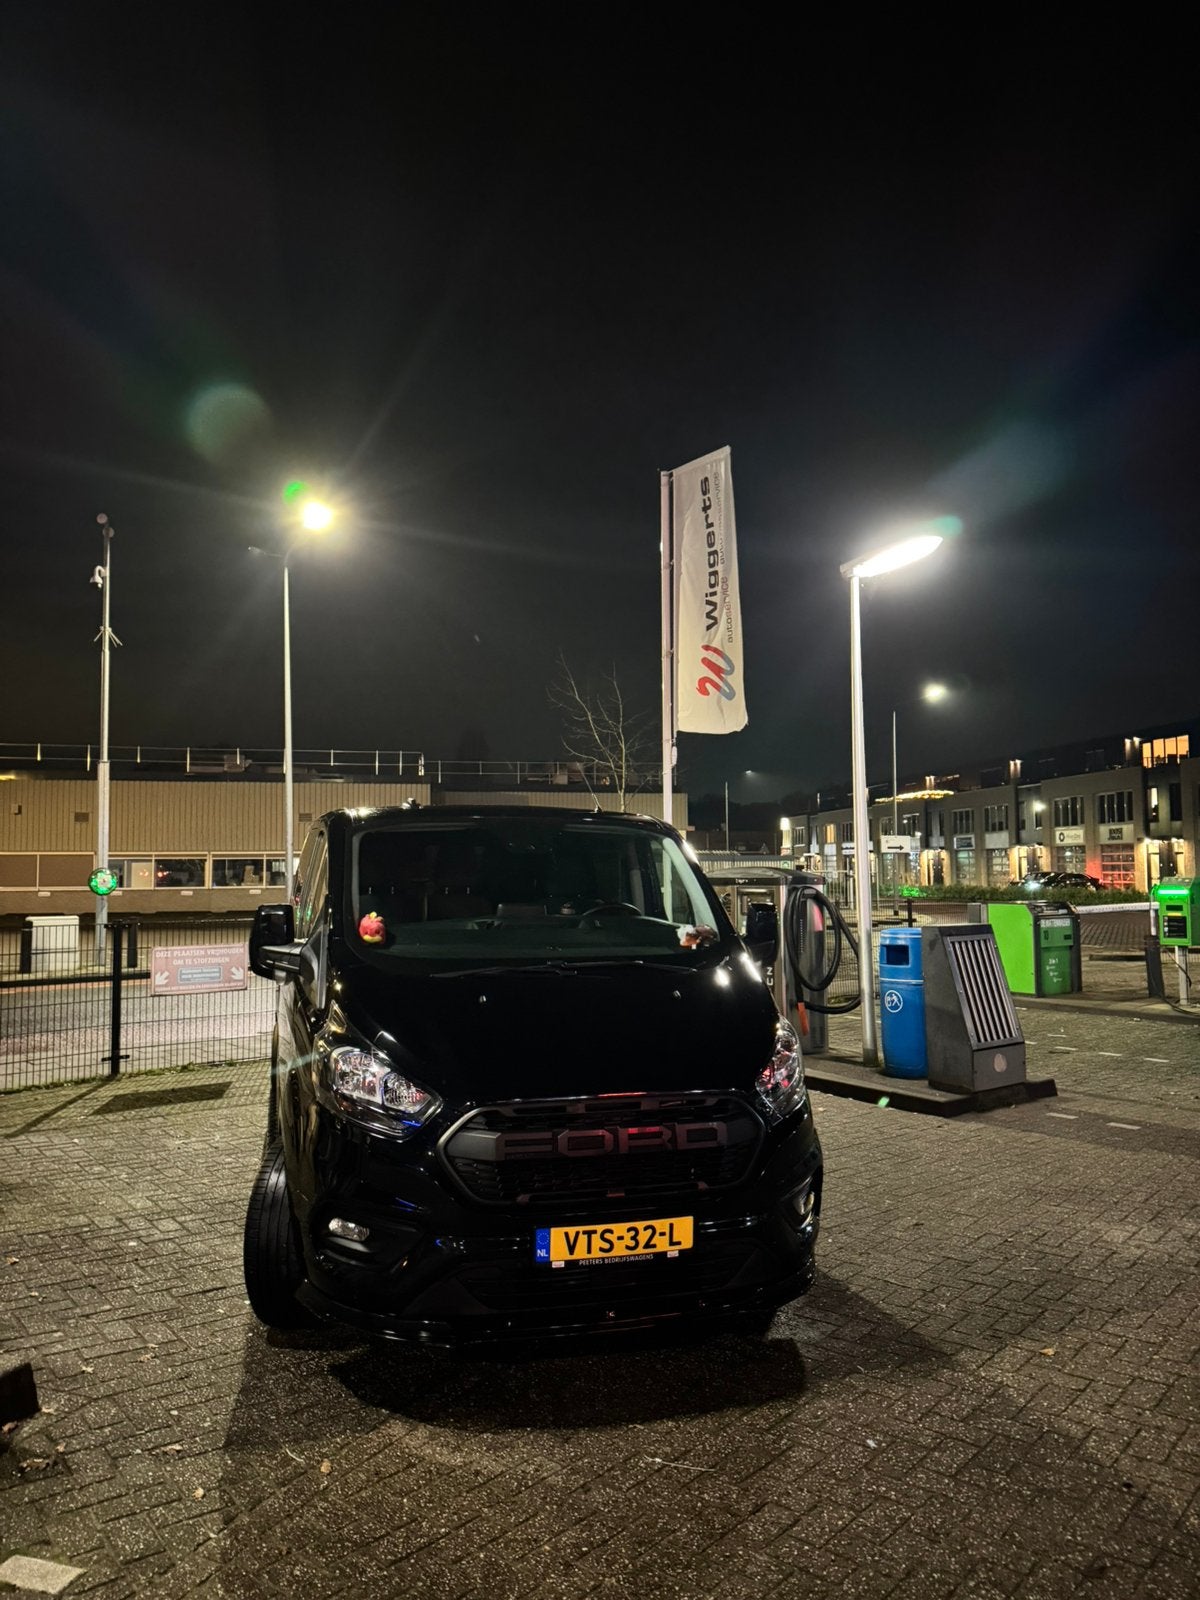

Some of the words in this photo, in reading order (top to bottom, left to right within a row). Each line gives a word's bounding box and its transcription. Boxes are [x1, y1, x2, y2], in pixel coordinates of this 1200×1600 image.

[700, 475, 720, 632] Wiggerts
[720, 575, 733, 643] autoservice
[173, 948, 205, 957] PLAATSEN
[495, 1121, 728, 1161] FORD
[536, 1249, 548, 1257] NL
[563, 1222, 682, 1256] VTS-32-L
[579, 1258, 603, 1266] PEETERS
[604, 1254, 654, 1264] BEDRIJFSWAGENS
